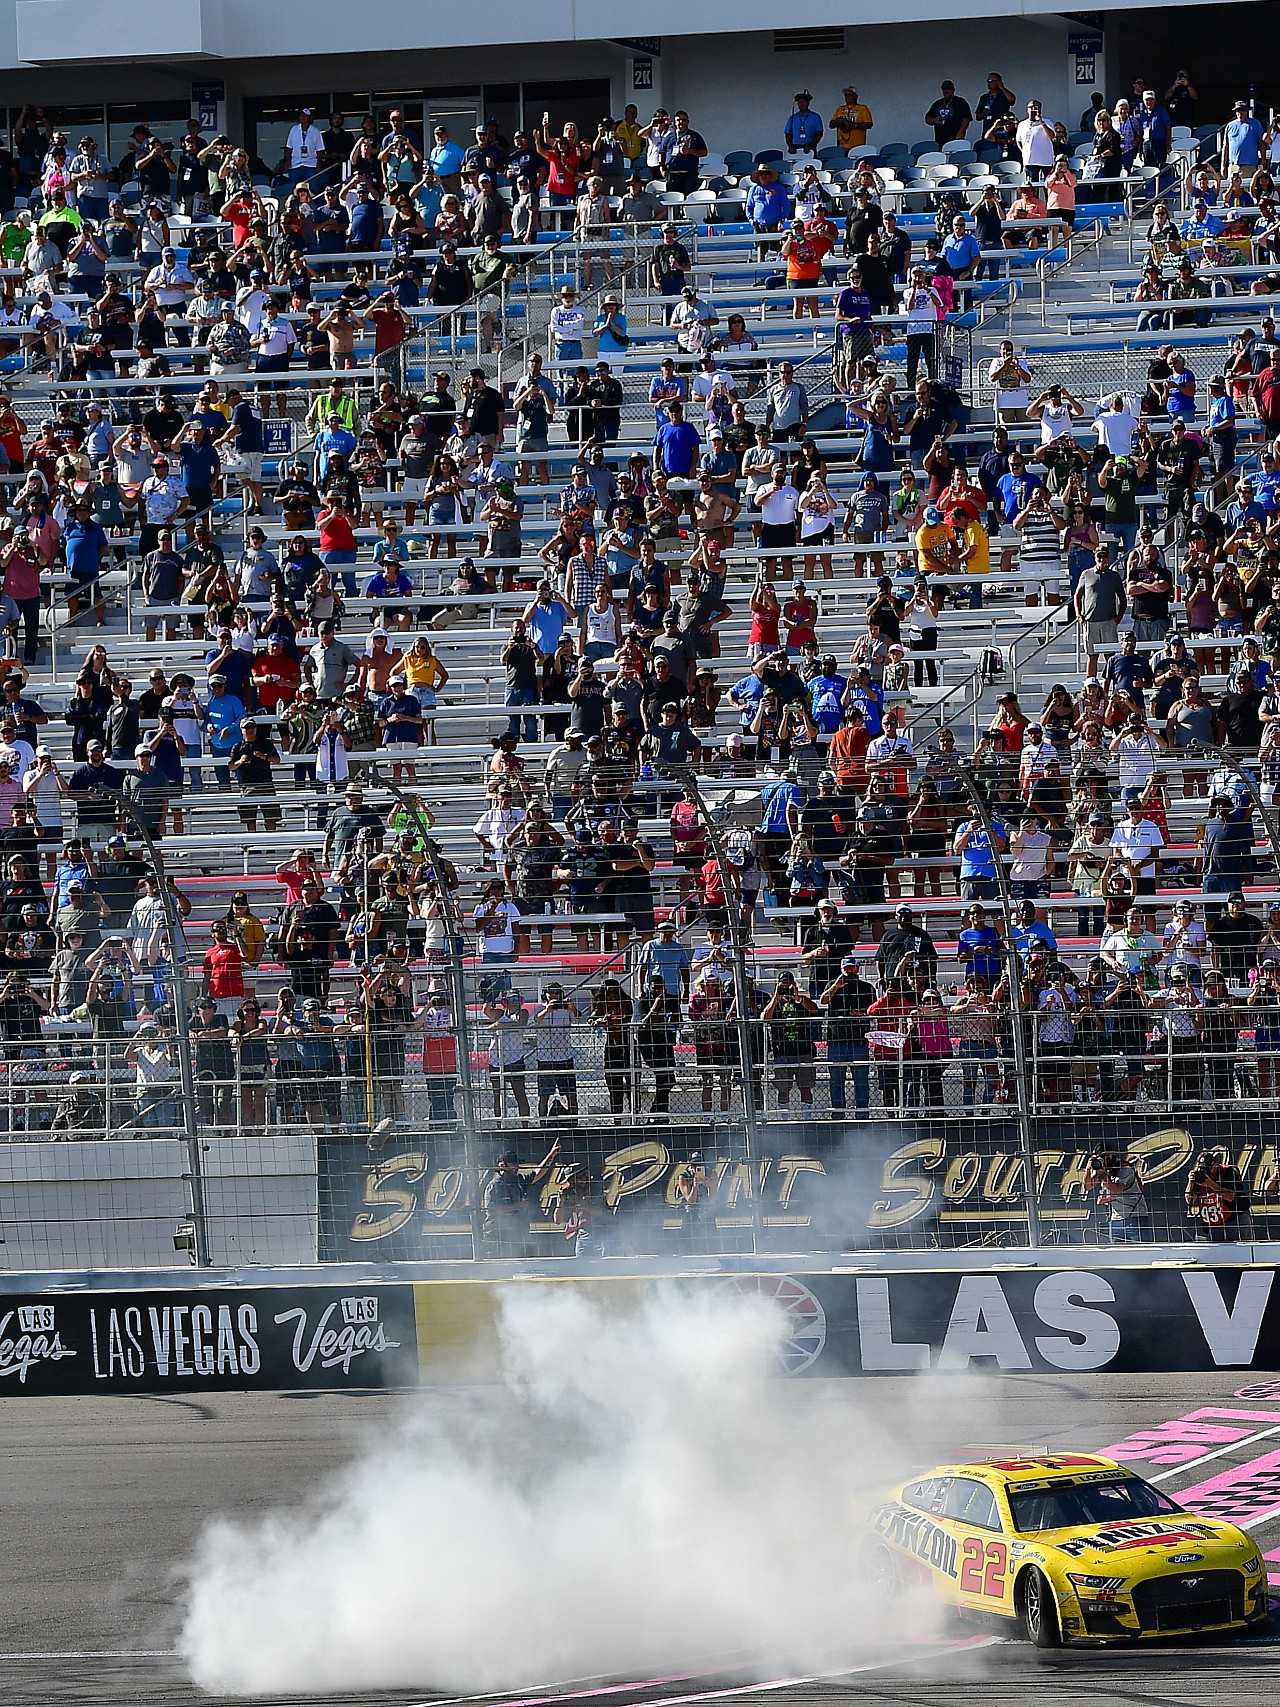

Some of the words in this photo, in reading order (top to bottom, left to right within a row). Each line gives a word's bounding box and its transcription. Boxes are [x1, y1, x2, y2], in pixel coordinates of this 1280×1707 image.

[635, 70, 650, 85] 2K
[1077, 65, 1093, 80] 2K
[201, 113, 215, 127] 2J
[273, 430, 283, 441] 2J
[20, 1307, 54, 1331] LAS
[343, 1297, 378, 1323] LAS
[855, 1271, 1121, 1373] LAS
[90, 1306, 144, 1378] LAS
[147, 1303, 261, 1376] VEGAS
[273, 1301, 402, 1375] Vegas
[1079, 1472, 1128, 1483] LOGANO
[960, 1537, 1007, 1599] 22
[1172, 1553, 1202, 1564] Ford
